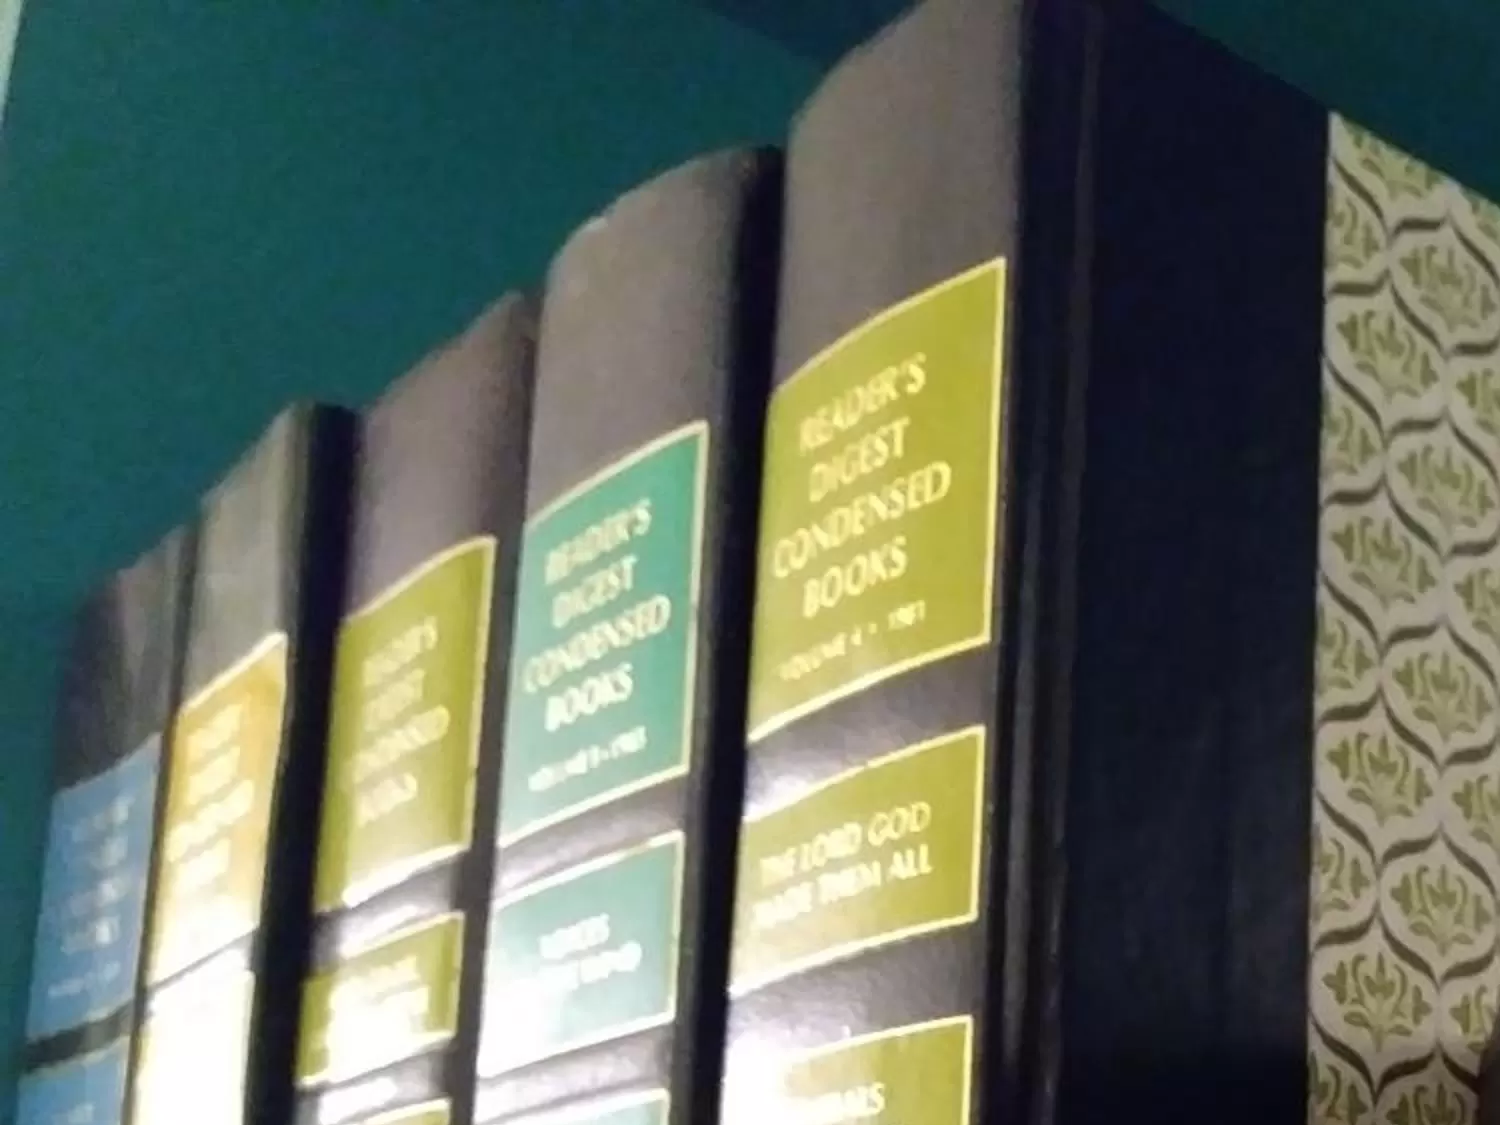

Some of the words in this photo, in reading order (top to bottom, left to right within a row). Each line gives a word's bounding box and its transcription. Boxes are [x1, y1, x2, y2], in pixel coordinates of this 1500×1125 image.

[799, 352, 927, 453] READER'S
[809, 417, 910, 502] DIGEST
[772, 460, 952, 578] CONDENSED
[803, 536, 907, 620] BOOKS
[544, 662, 634, 731] BOOKS
[801, 822, 862, 871] LORD
[868, 802, 931, 847] GOD
[887, 843, 933, 881] ALL
